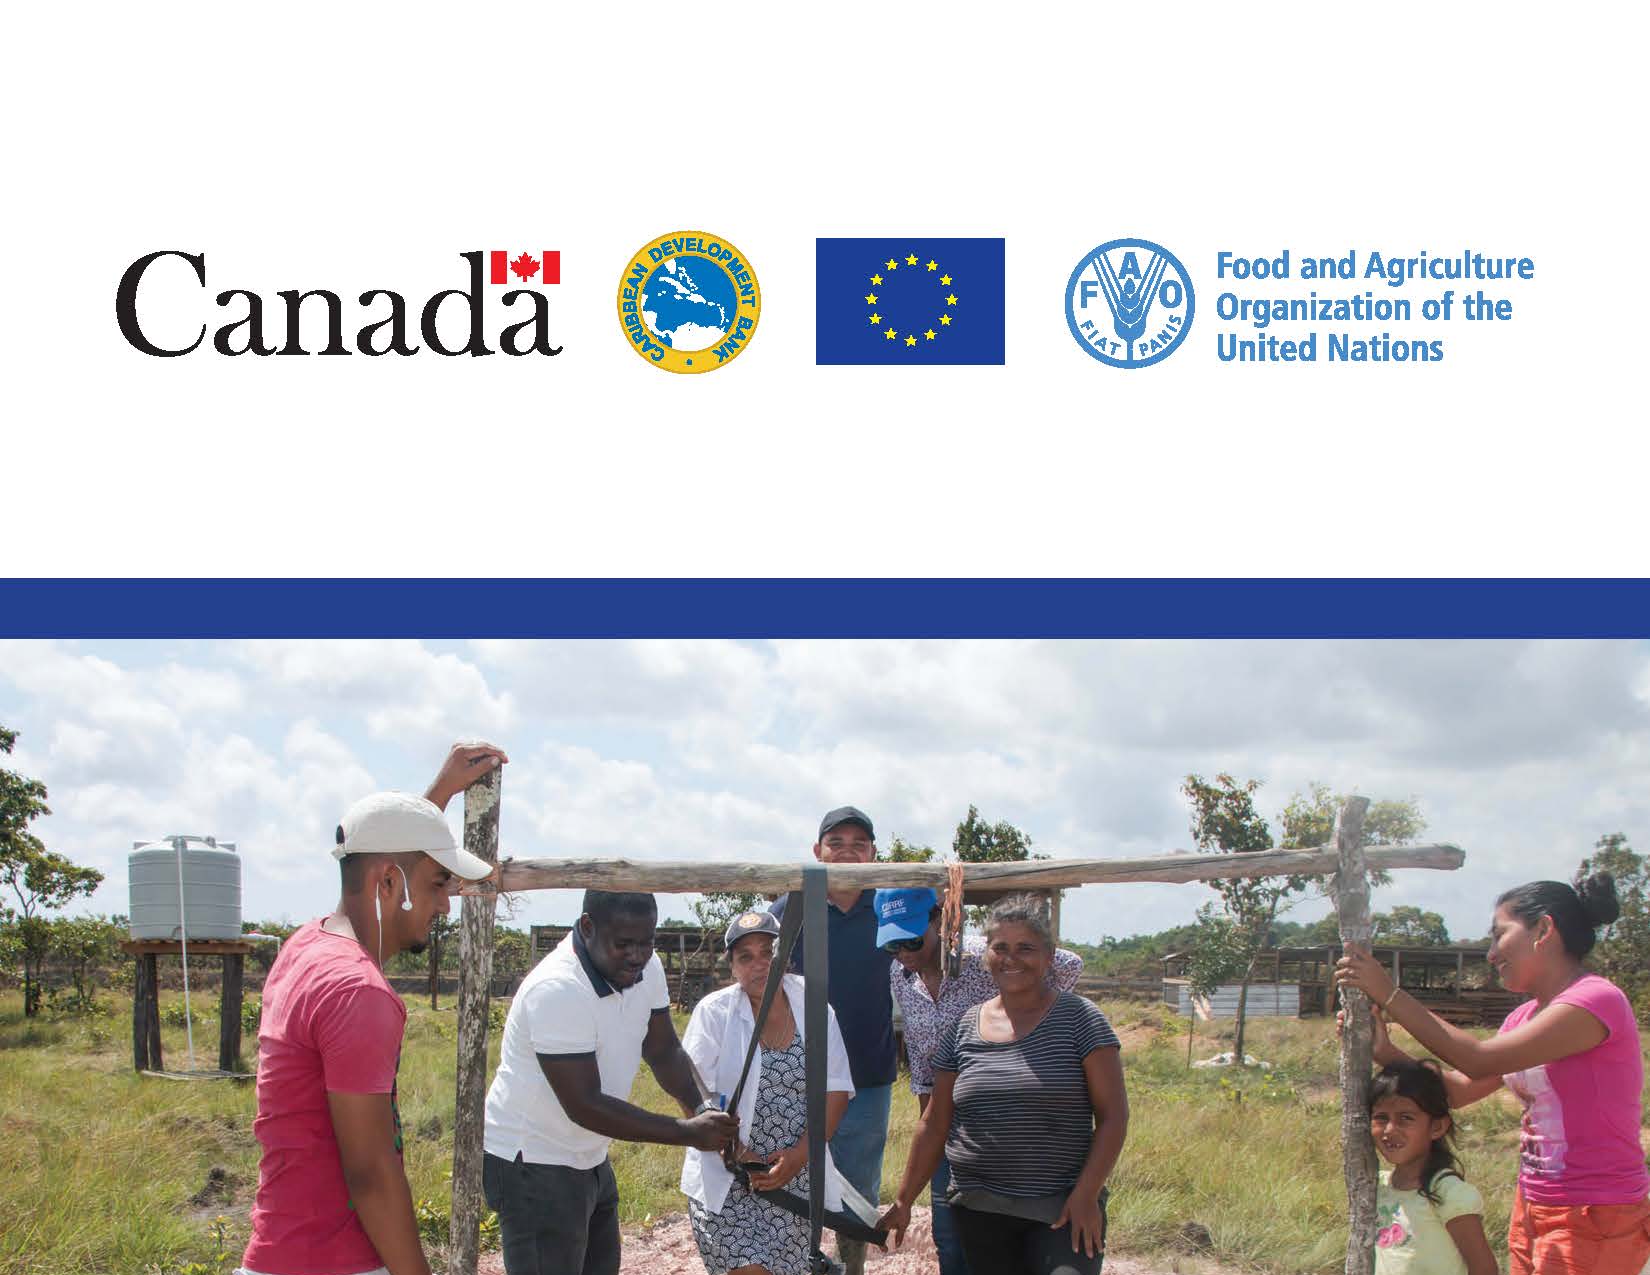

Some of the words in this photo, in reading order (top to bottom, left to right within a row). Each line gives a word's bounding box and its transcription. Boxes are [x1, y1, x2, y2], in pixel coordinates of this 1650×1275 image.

[1218, 250, 1289, 279] Food
[1301, 250, 1355, 279] and
[1364, 250, 1534, 287] Agriculture
[116, 251, 563, 357] Canada
[623, 263, 665, 361] CARIBBEAN
[649, 238, 756, 307] DEVELOPMENT
[712, 316, 753, 363] BANK
[1217, 292, 1410, 328] Organization
[1422, 291, 1454, 320] of
[1463, 291, 1512, 320] the
[1079, 318, 1122, 357] FIAT
[1138, 313, 1182, 358] PANIS
[1218, 333, 1316, 361] United
[1329, 333, 1443, 361] Nations
